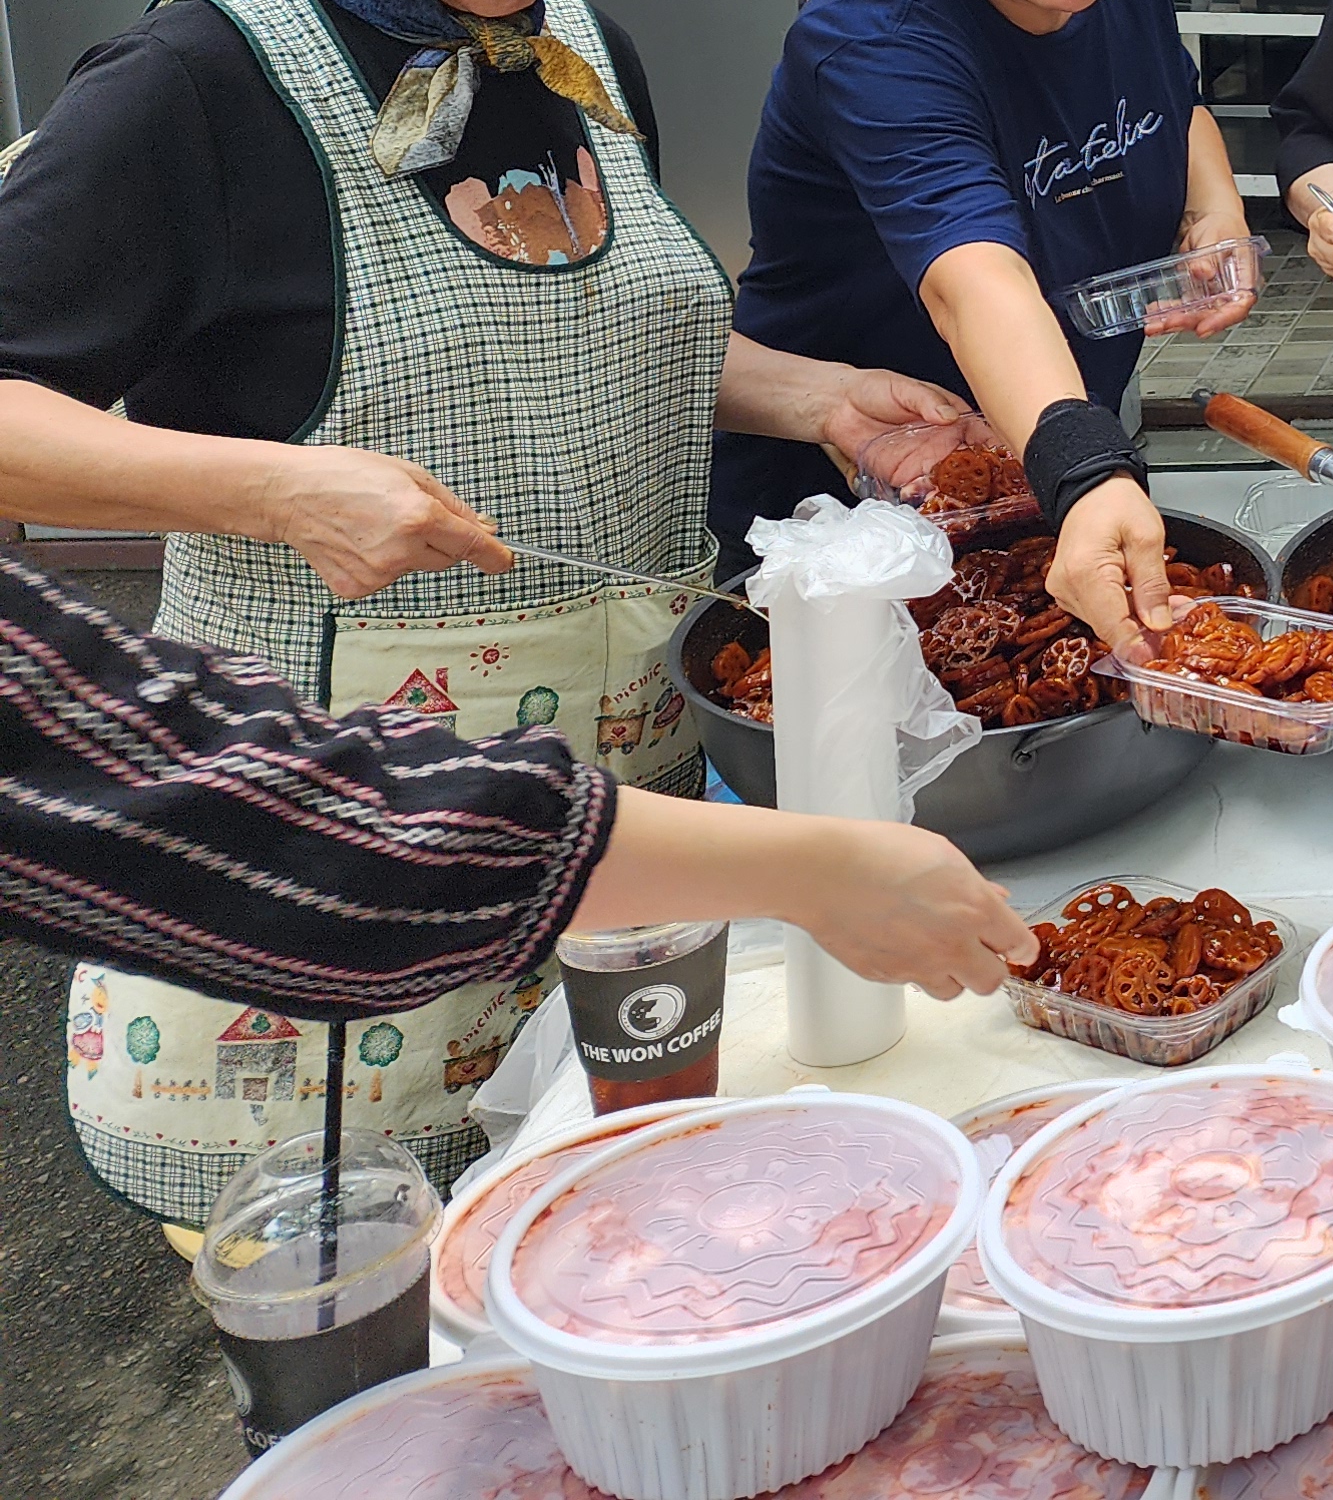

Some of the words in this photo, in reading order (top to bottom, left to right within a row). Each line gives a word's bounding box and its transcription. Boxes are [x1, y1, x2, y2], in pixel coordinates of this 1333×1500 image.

[580, 1042, 611, 1063] THE
[611, 1043, 663, 1063] WON
[666, 1008, 721, 1053] COFFEE
